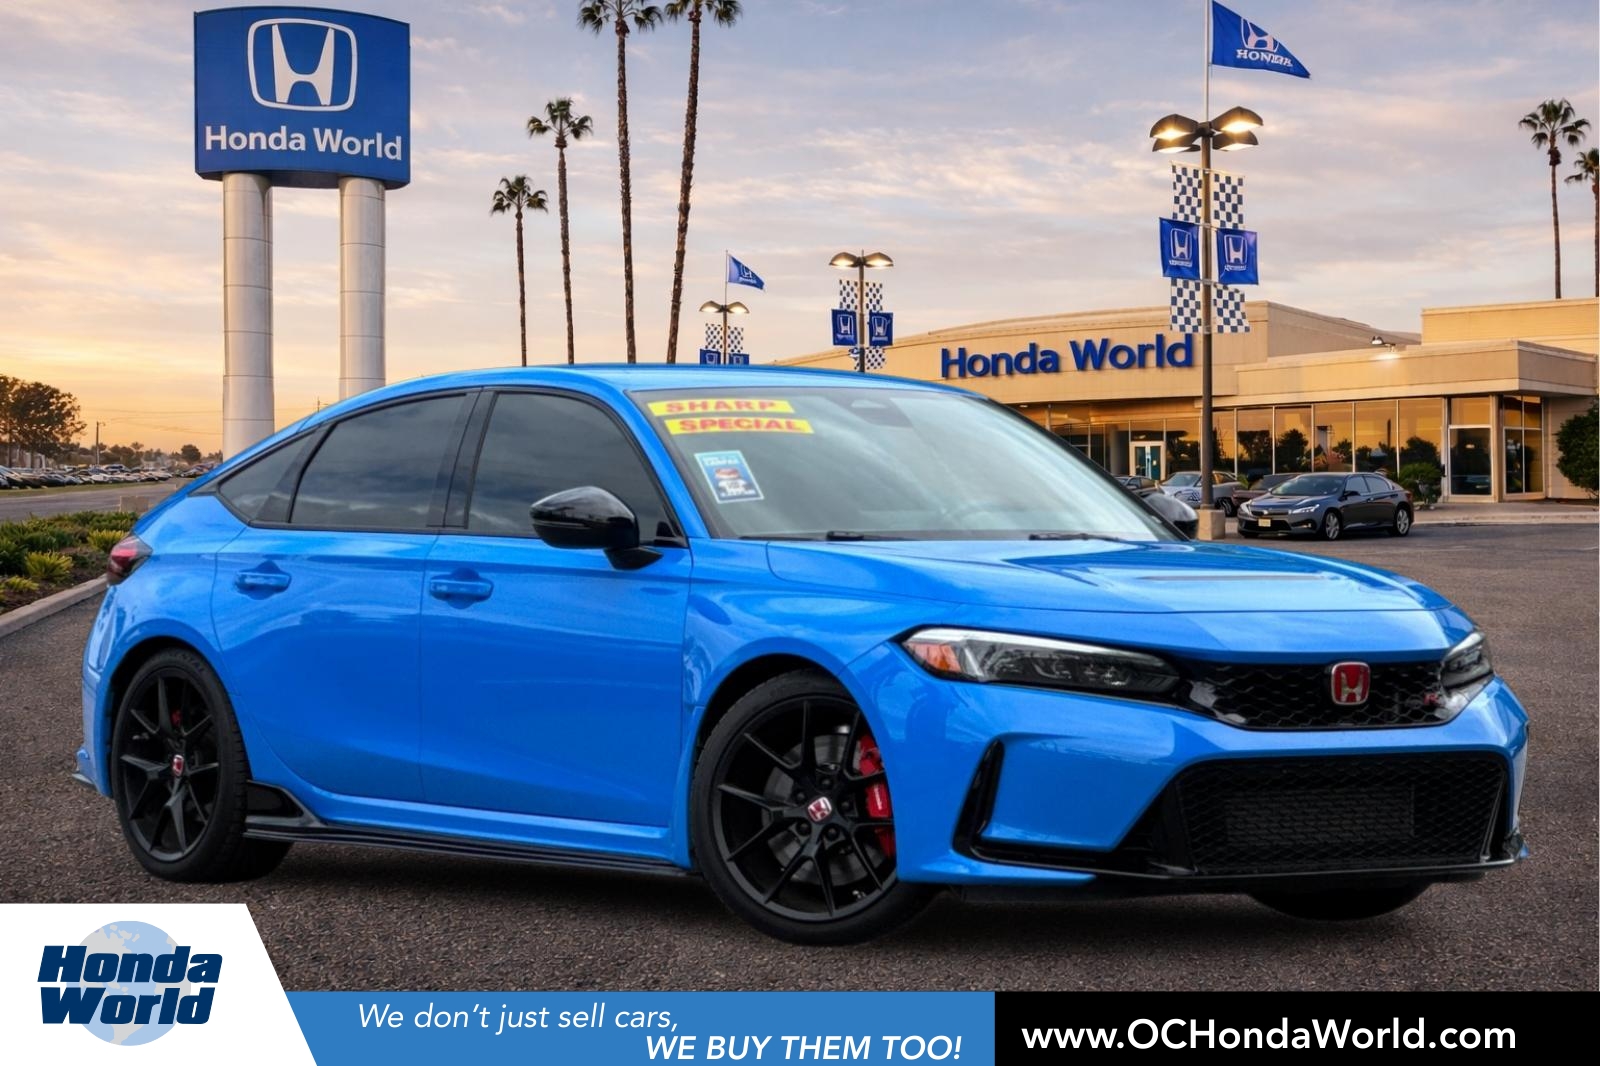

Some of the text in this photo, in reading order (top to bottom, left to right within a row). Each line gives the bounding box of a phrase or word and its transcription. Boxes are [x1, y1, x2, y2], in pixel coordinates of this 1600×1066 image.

[205, 125, 402, 161] Honda World
[941, 333, 1194, 379] Honda World
[666, 400, 776, 413] SHARP
[679, 418, 801, 432] SPECIAL
